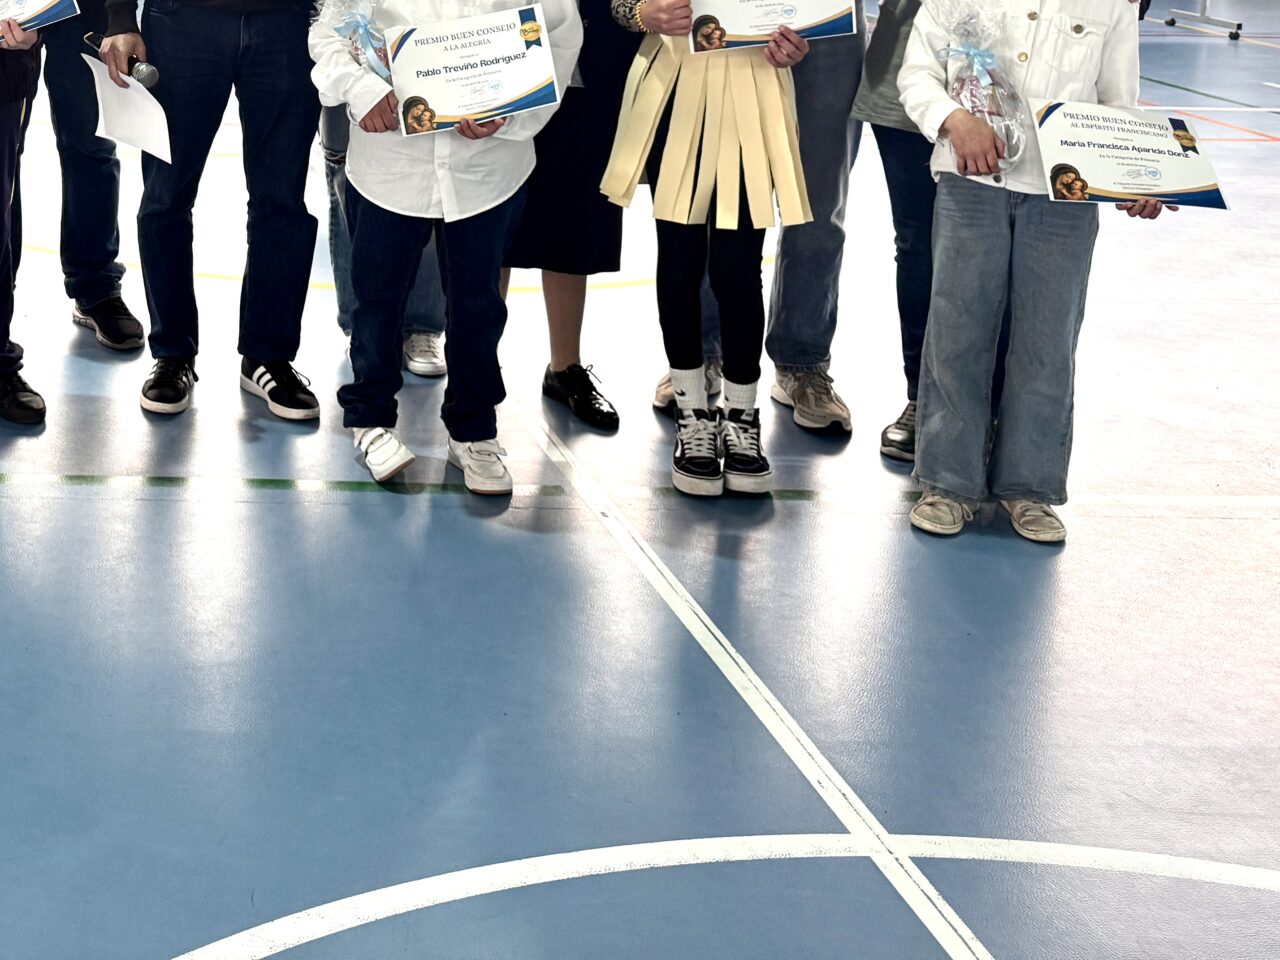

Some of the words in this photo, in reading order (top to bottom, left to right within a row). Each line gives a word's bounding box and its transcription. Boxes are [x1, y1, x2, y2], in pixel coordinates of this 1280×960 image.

[415, 35, 449, 46] PREMIO
[451, 31, 475, 41] BUEN
[477, 23, 516, 36] CONSEJO
[460, 38, 491, 50] ALEGRÍA
[416, 68, 441, 78] Pablo
[443, 61, 478, 74] Treviño
[480, 52, 527, 67] Rodríguez
[1063, 112, 1100, 122] PREMIO
[1102, 117, 1126, 125] BUEN
[1128, 120, 1168, 132] CONSEJO
[1082, 123, 1115, 132] ESPÍRITU
[1117, 128, 1168, 138] FRANCISCANO
[1087, 141, 1129, 150] Francisca
[1132, 146, 1166, 154] Aparicio
